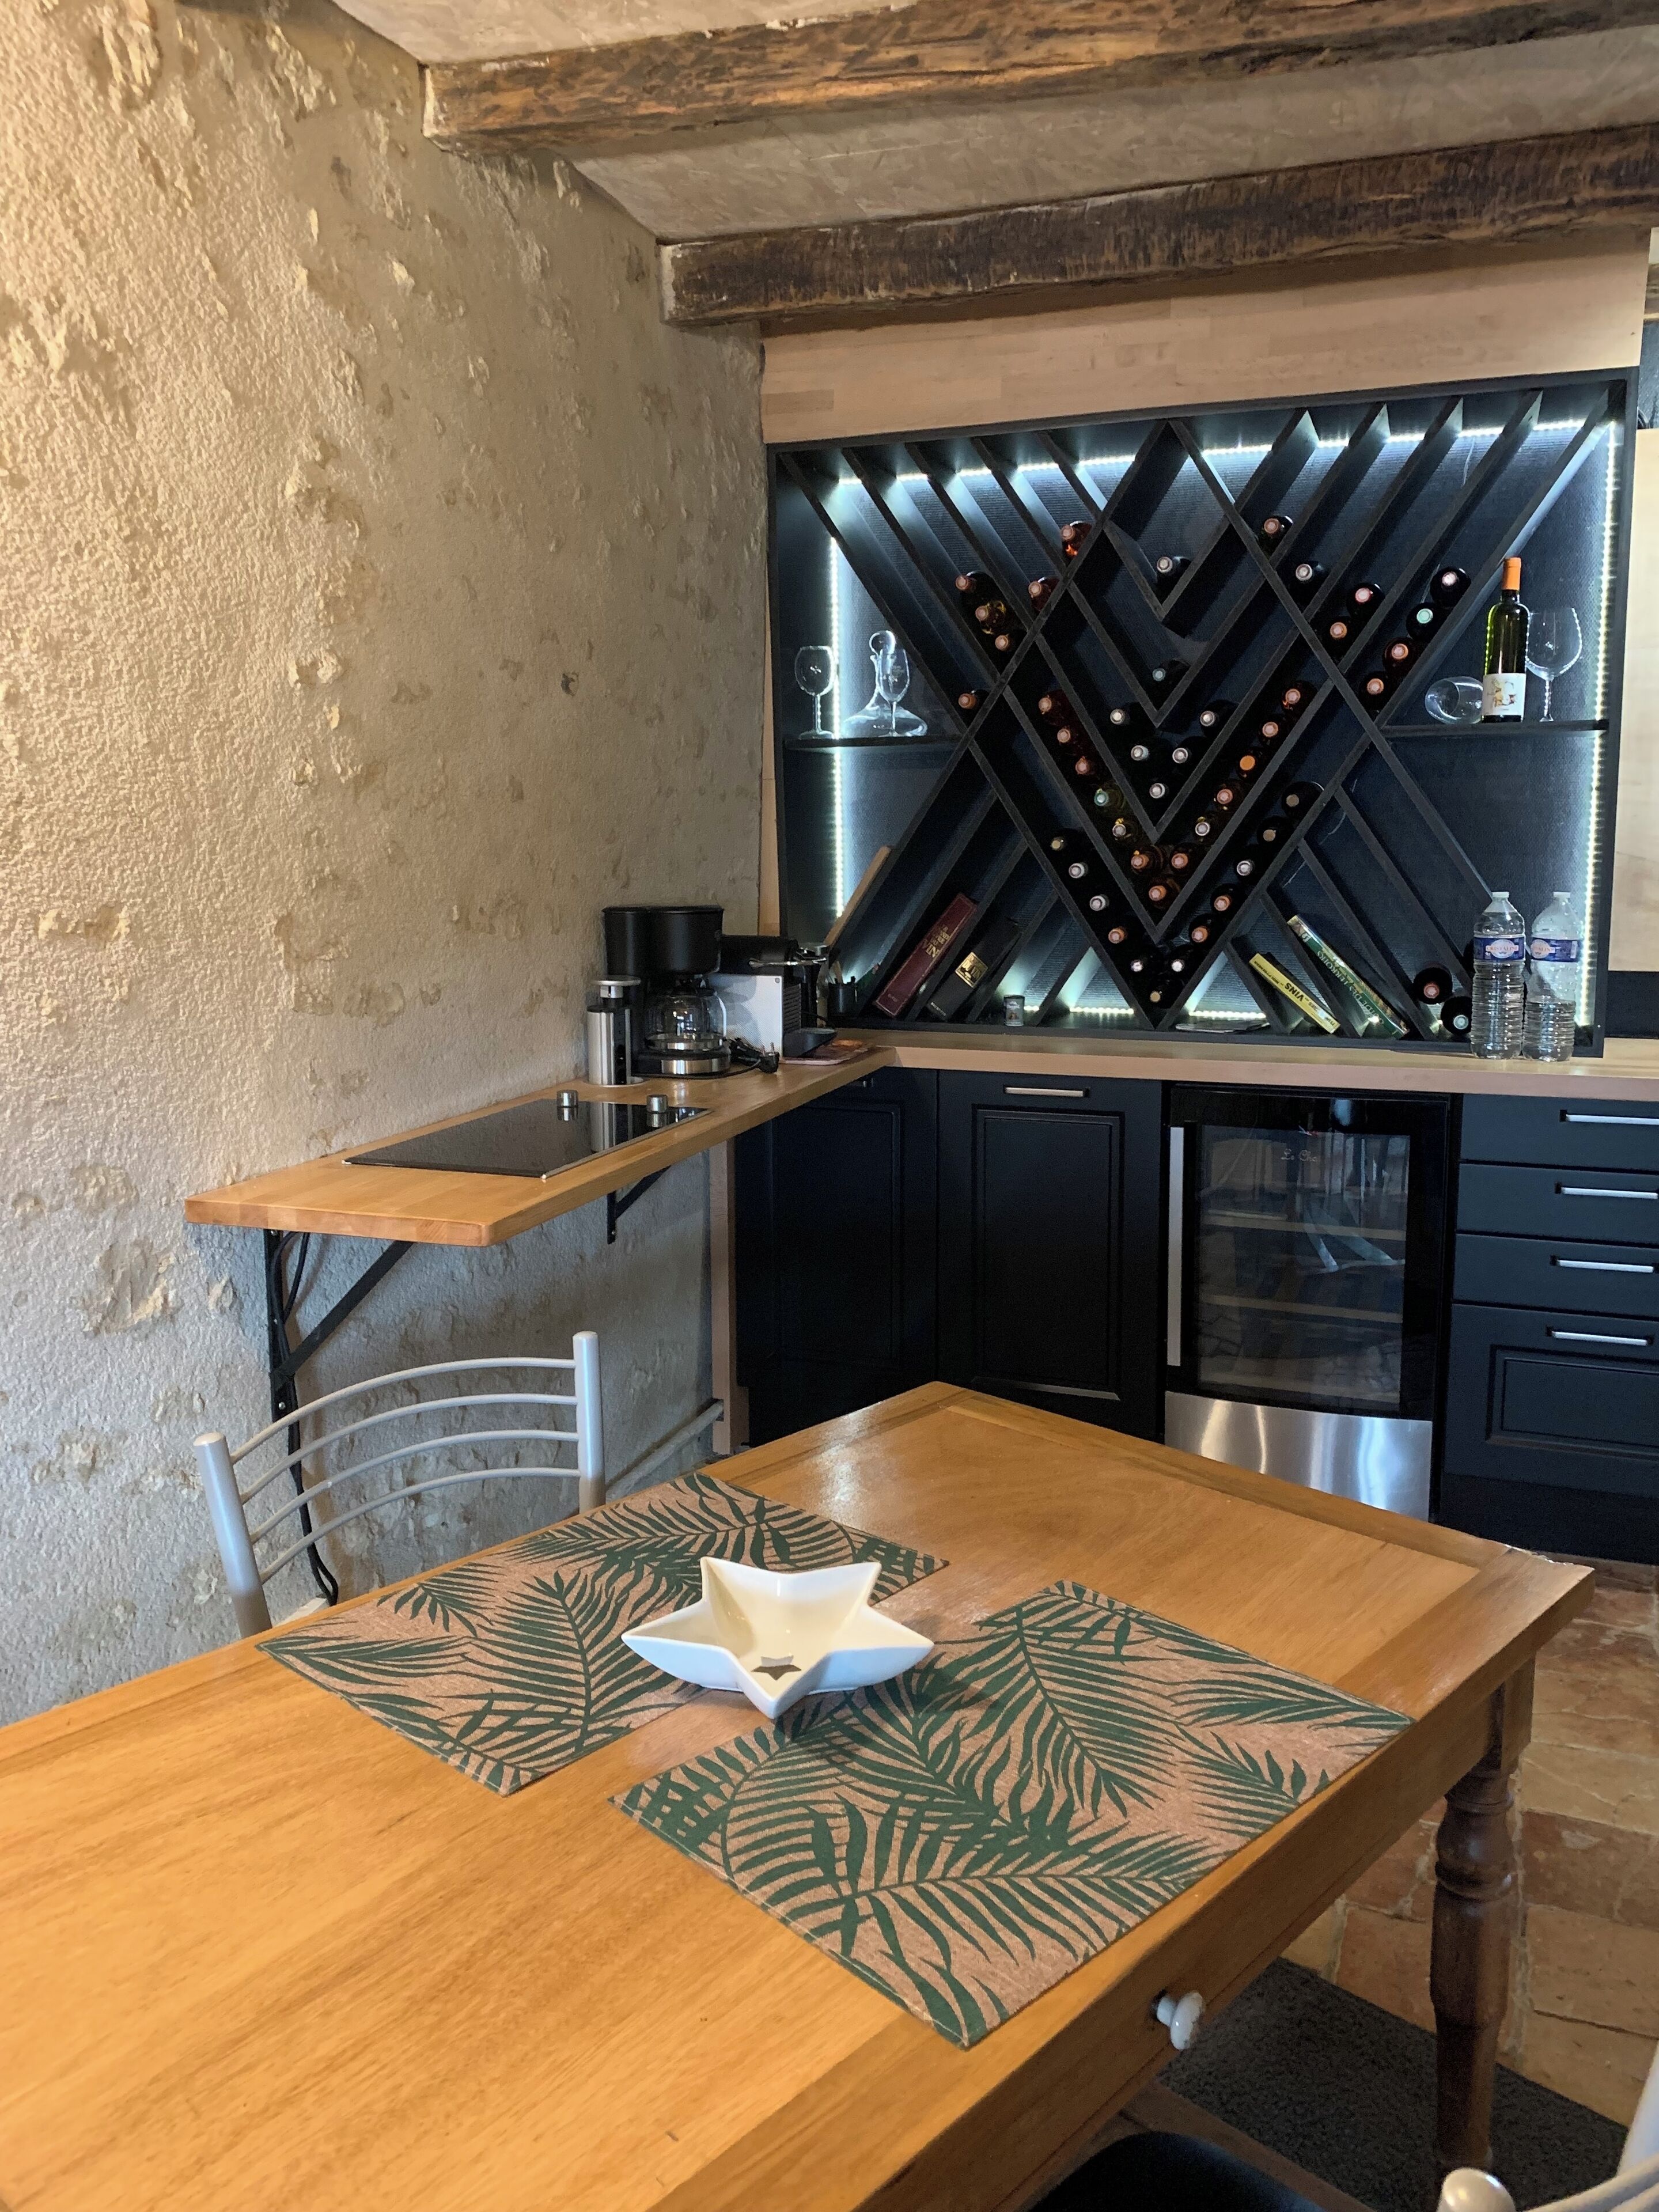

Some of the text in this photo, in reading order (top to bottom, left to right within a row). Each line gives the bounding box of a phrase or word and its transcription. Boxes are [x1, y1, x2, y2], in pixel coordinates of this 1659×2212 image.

[921, 940, 941, 958] VIN
[1317, 950, 1348, 984] TERROIRS
[1285, 983, 1304, 1002] VINS
[1349, 986, 1362, 1001] DES
[1281, 1148, 1294, 1160] Le
